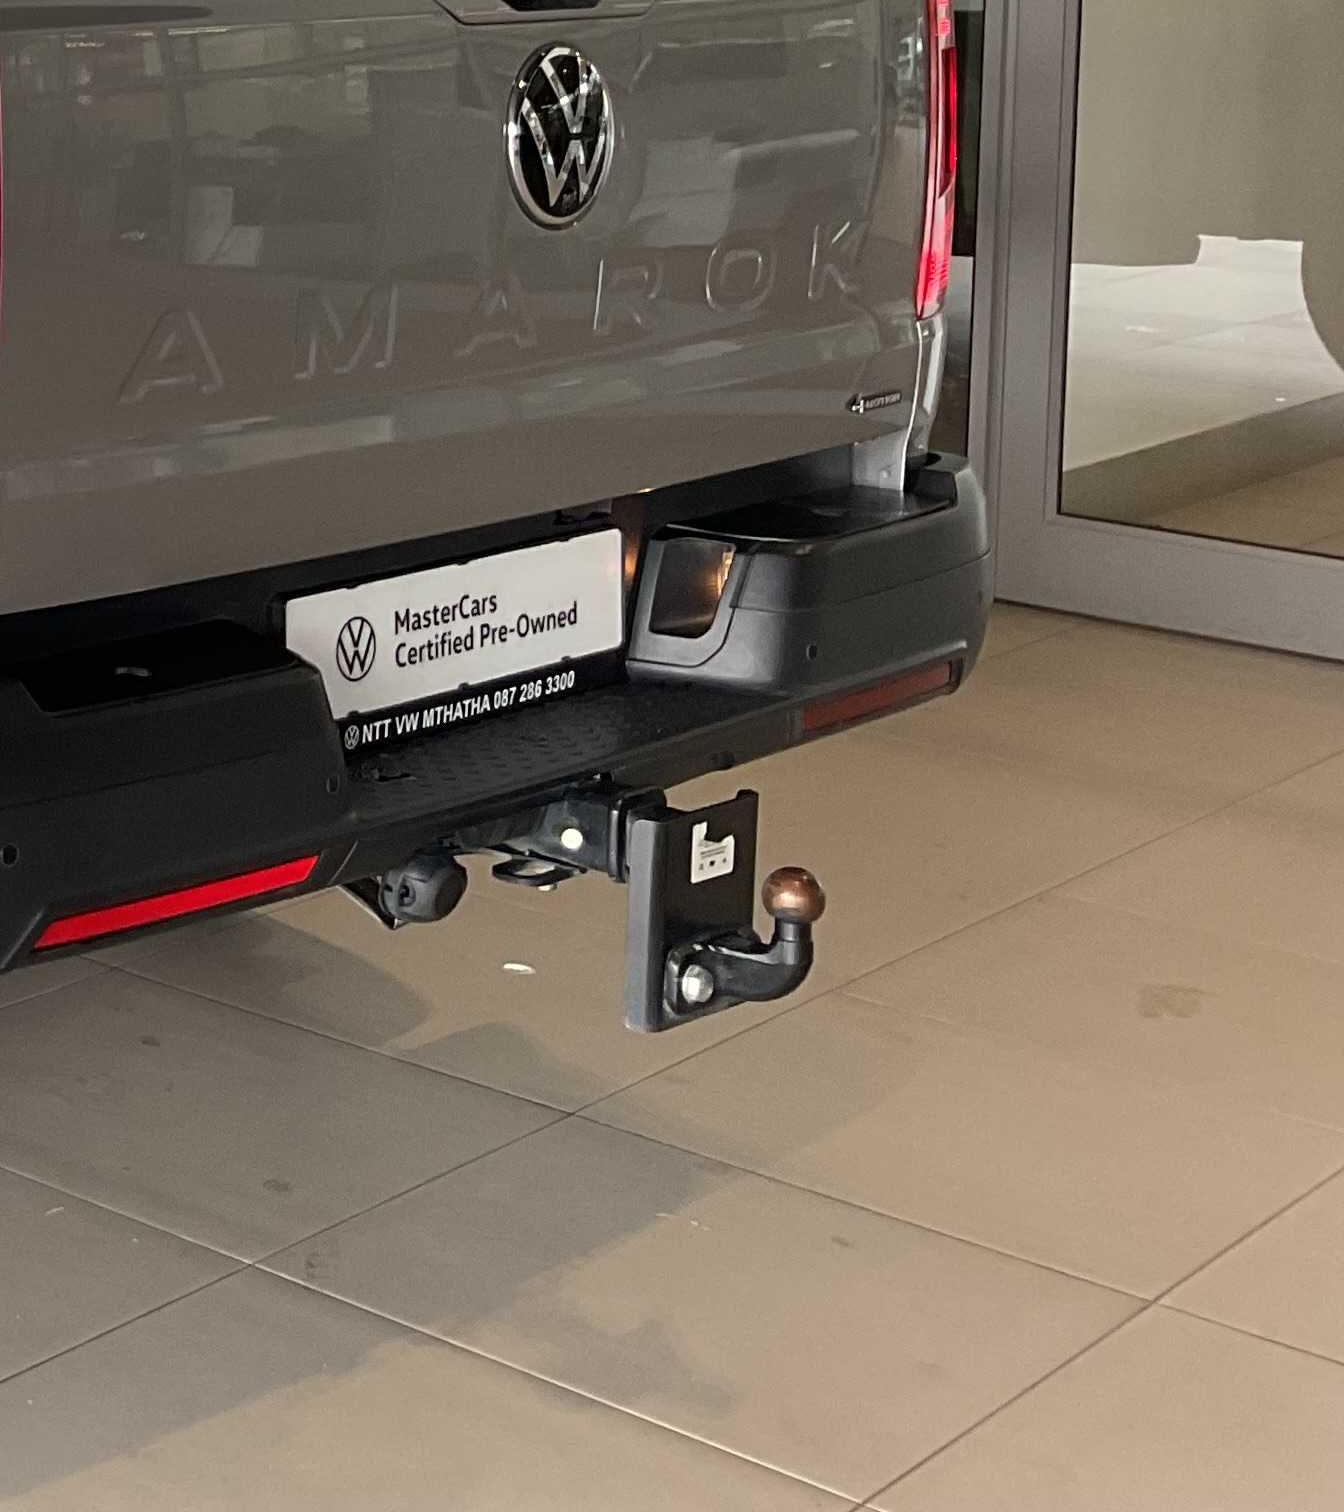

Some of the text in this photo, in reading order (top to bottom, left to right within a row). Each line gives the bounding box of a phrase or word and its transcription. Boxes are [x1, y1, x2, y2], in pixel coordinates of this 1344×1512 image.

[116, 220, 862, 403] AMAROK
[395, 594, 497, 634] MasterCars
[395, 600, 578, 668] Certified Pre-Owned
[362, 670, 575, 744] NTT VW MTHATHA 087 286 3300
